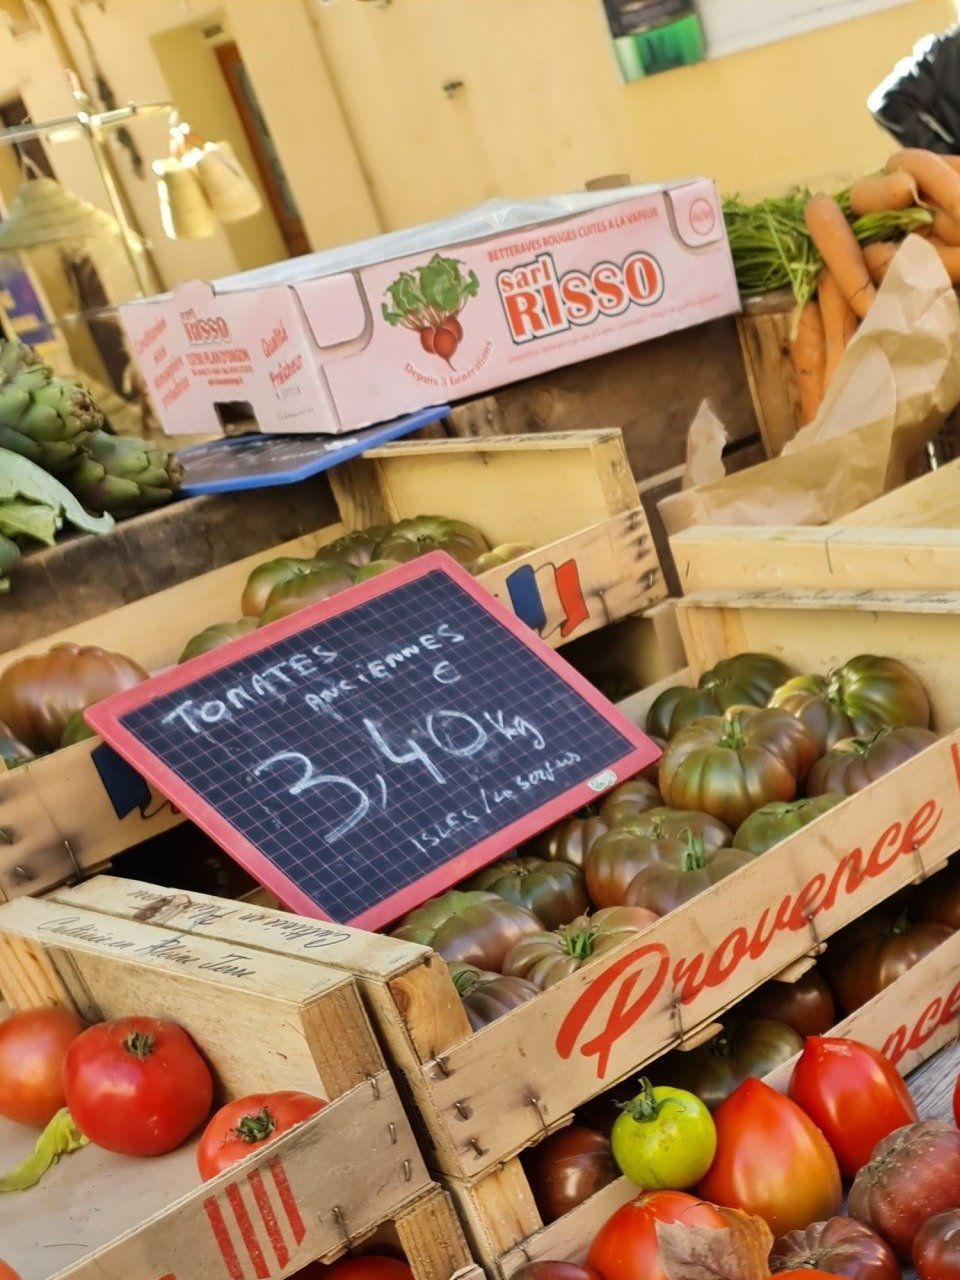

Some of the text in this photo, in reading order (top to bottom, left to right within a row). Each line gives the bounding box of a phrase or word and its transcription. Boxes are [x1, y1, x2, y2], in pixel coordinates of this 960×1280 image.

[487, 240, 542, 262] BETTERAVES
[543, 229, 577, 249] ROUGES
[578, 220, 607, 238] CUITES
[499, 257, 553, 294] sarl
[502, 254, 661, 340] RISSO
[161, 645, 338, 733] TOMATES
[433, 660, 461, 684] €
[253, 711, 487, 843] 3,40
[555, 800, 943, 1080] Provence
